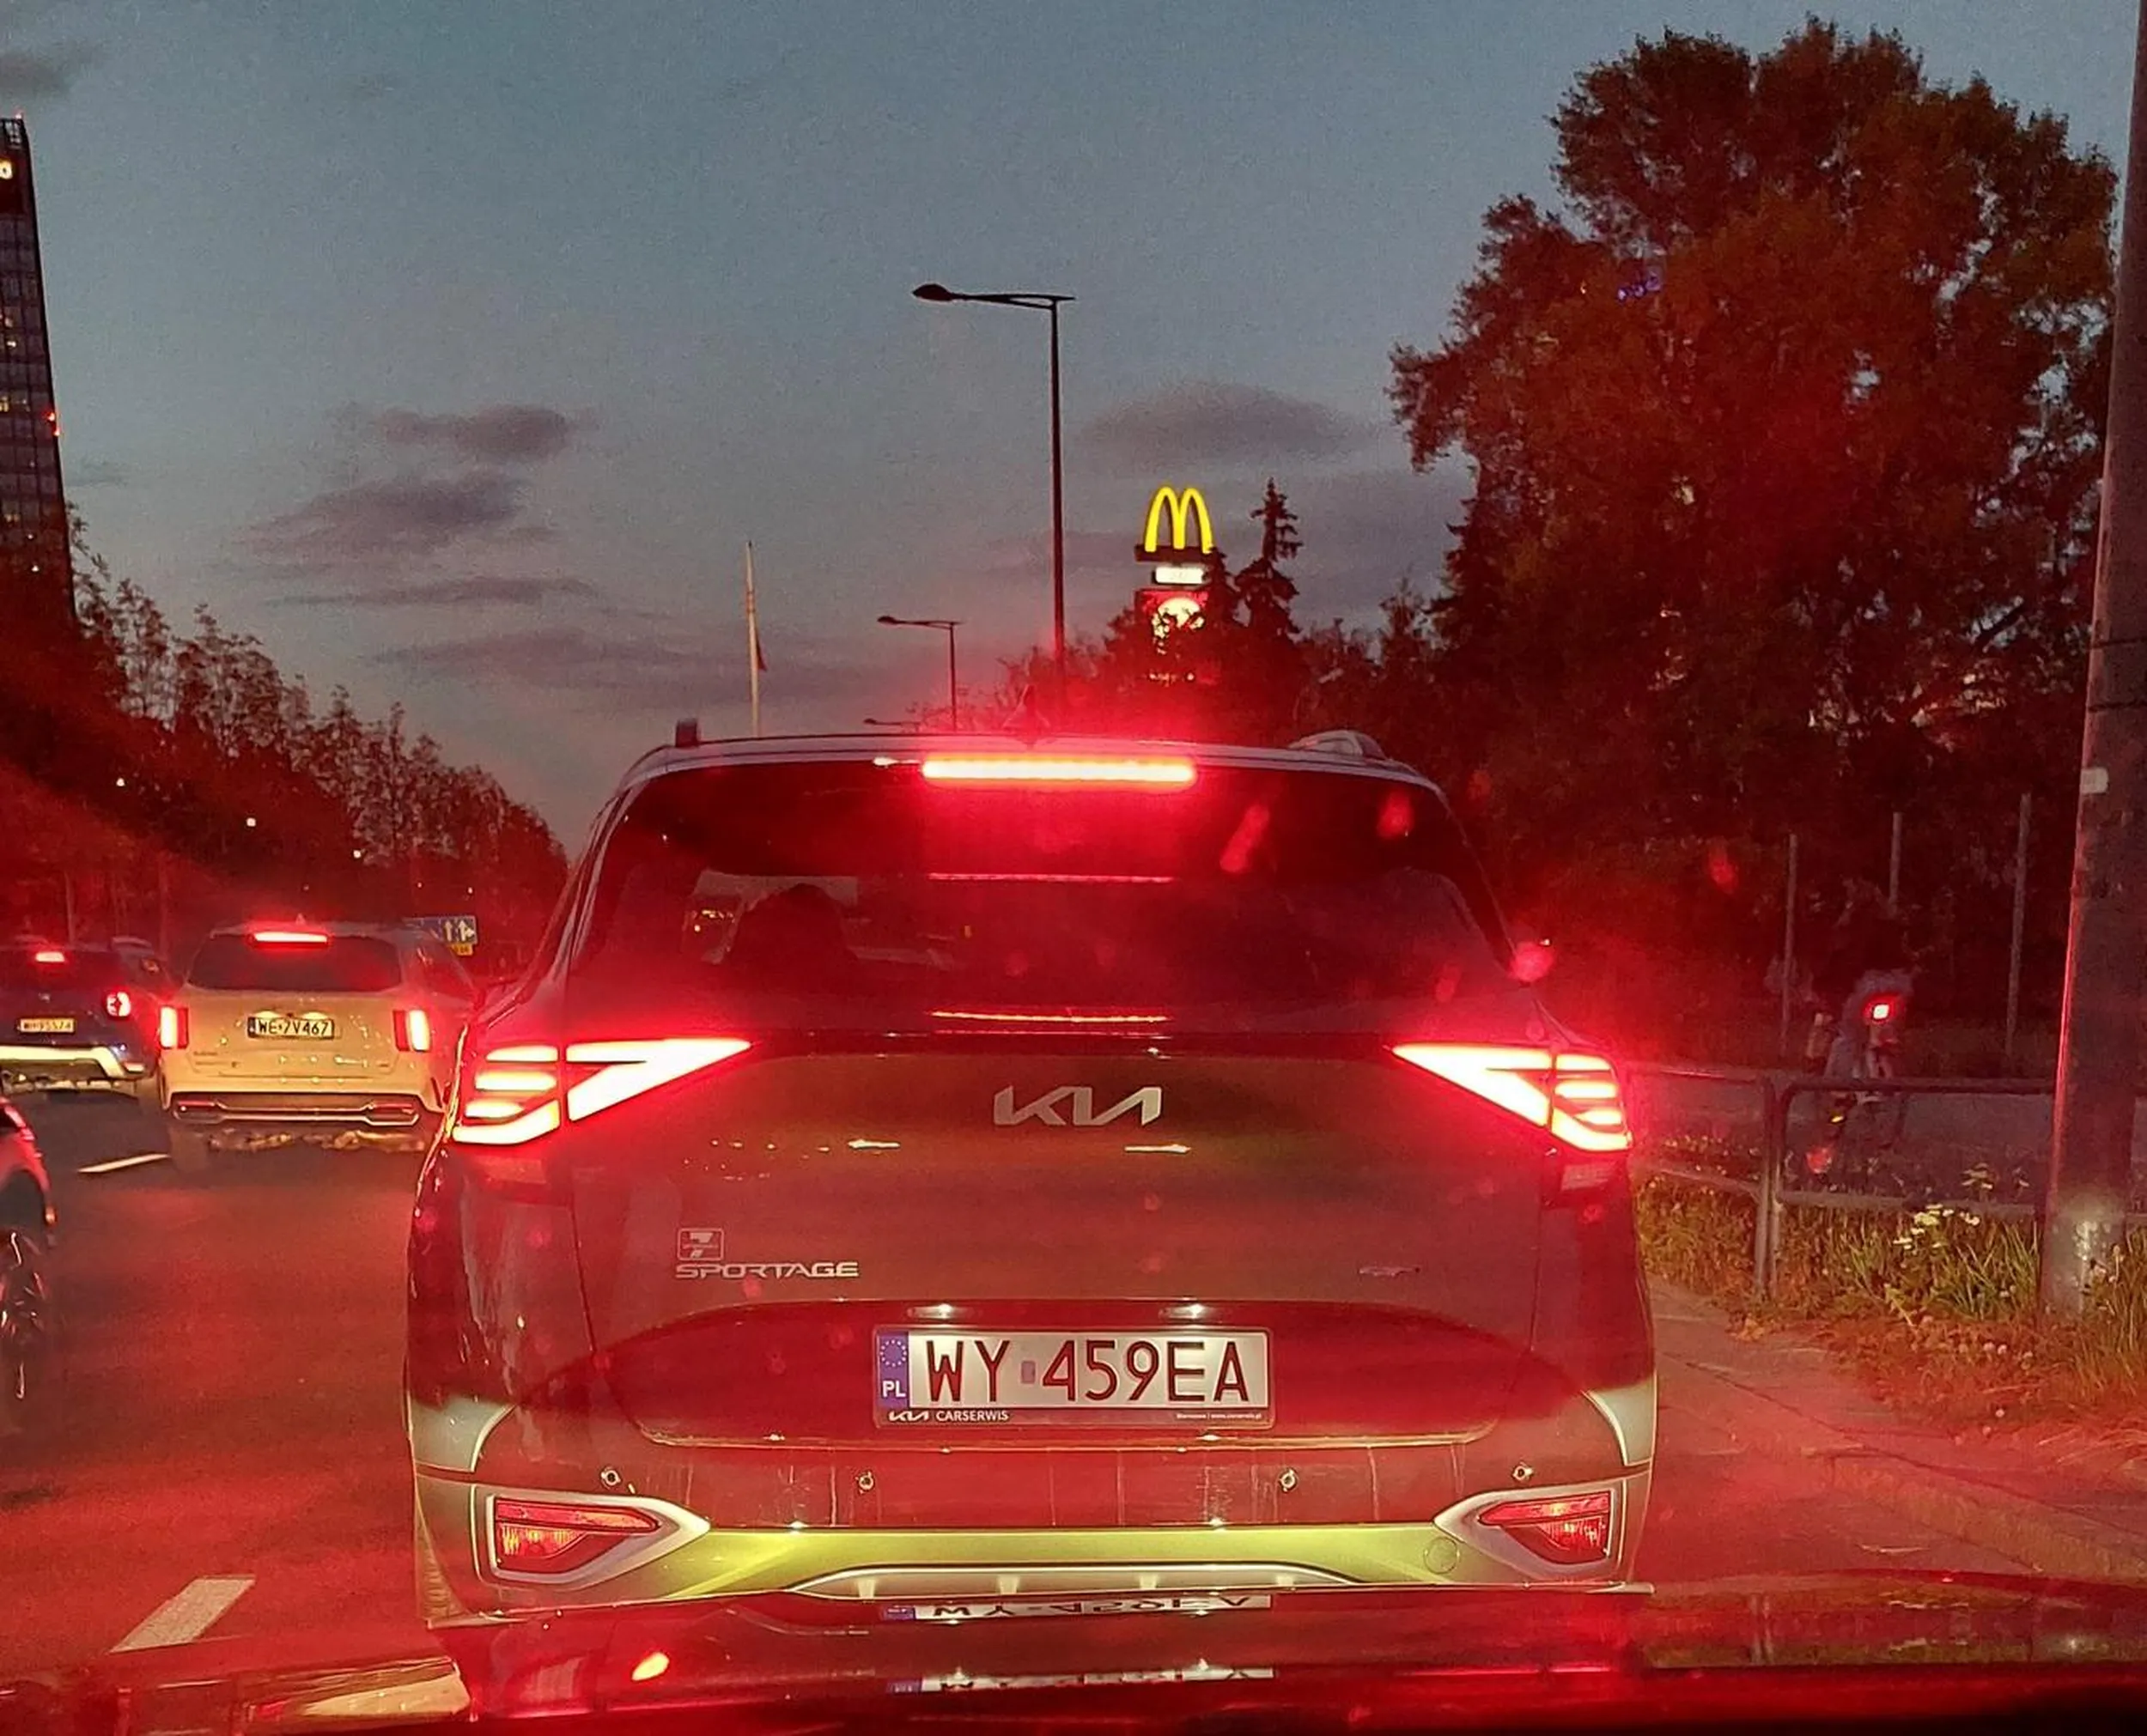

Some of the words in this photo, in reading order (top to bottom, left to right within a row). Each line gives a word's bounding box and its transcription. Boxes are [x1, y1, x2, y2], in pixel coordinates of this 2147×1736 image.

[258, 1018, 277, 1034] WE
[283, 1019, 329, 1035] 7V467
[993, 1085, 1161, 1126] KIA
[676, 1261, 859, 1279] SPORTAGE
[926, 1340, 1010, 1402] WY
[1042, 1340, 1250, 1402] 459EA
[882, 1380, 906, 1398] PL
[888, 1410, 929, 1422] KIA
[935, 1410, 1009, 1422] CARSERWIS
